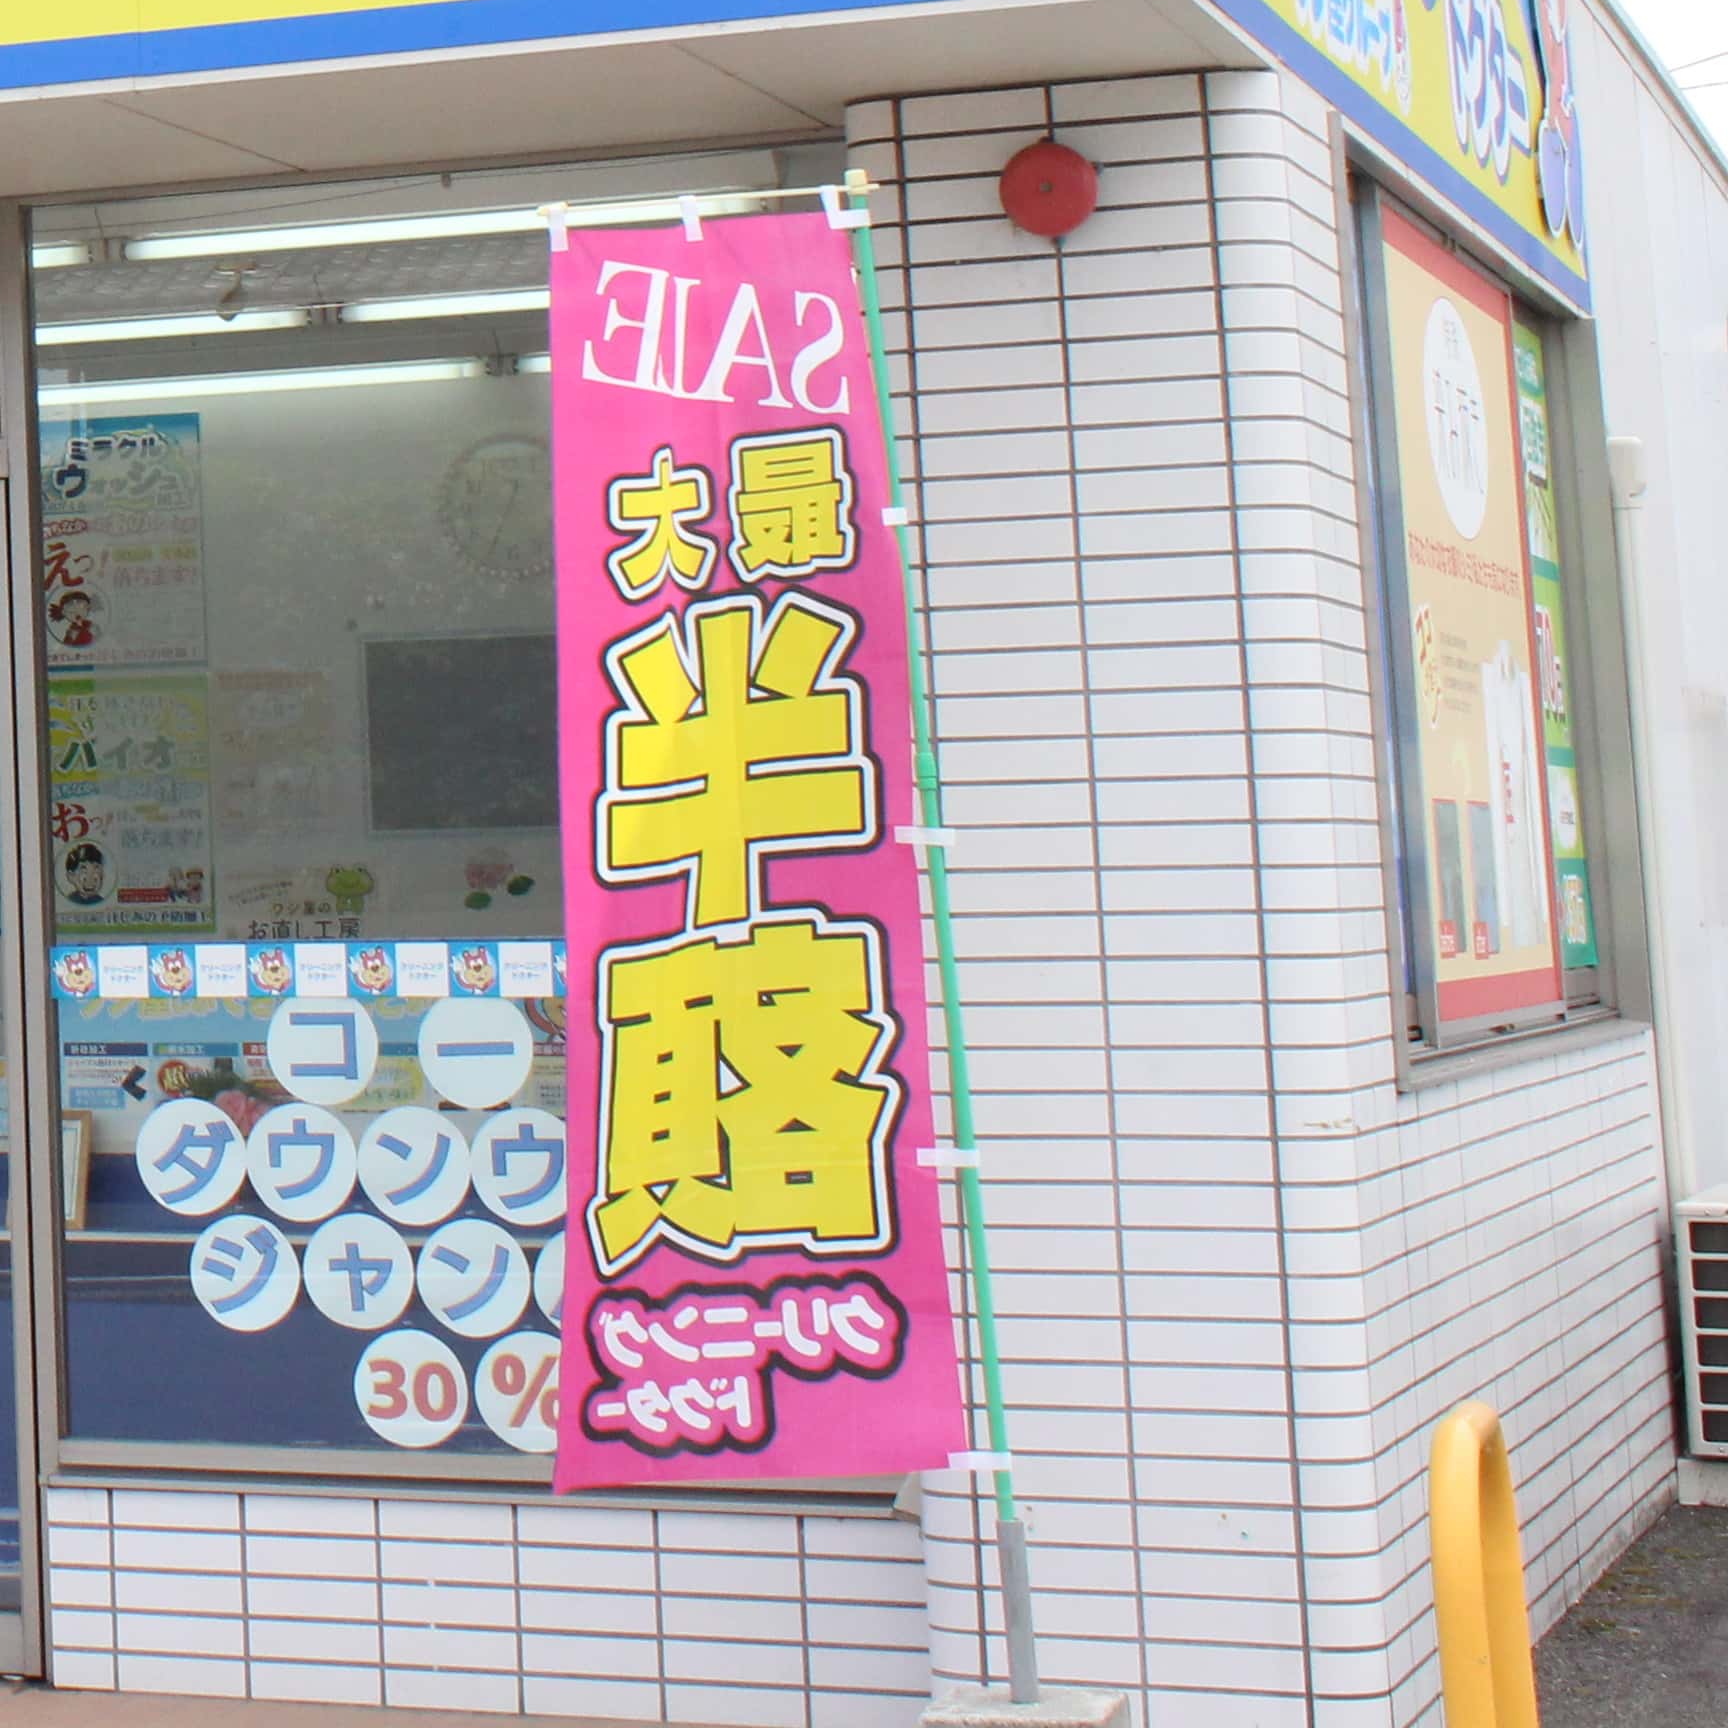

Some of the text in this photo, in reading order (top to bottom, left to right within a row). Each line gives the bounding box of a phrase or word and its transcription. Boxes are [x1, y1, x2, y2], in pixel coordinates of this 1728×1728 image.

[248, 918, 362, 939] お直し工房
[200, 1224, 562, 1321] ジャン
